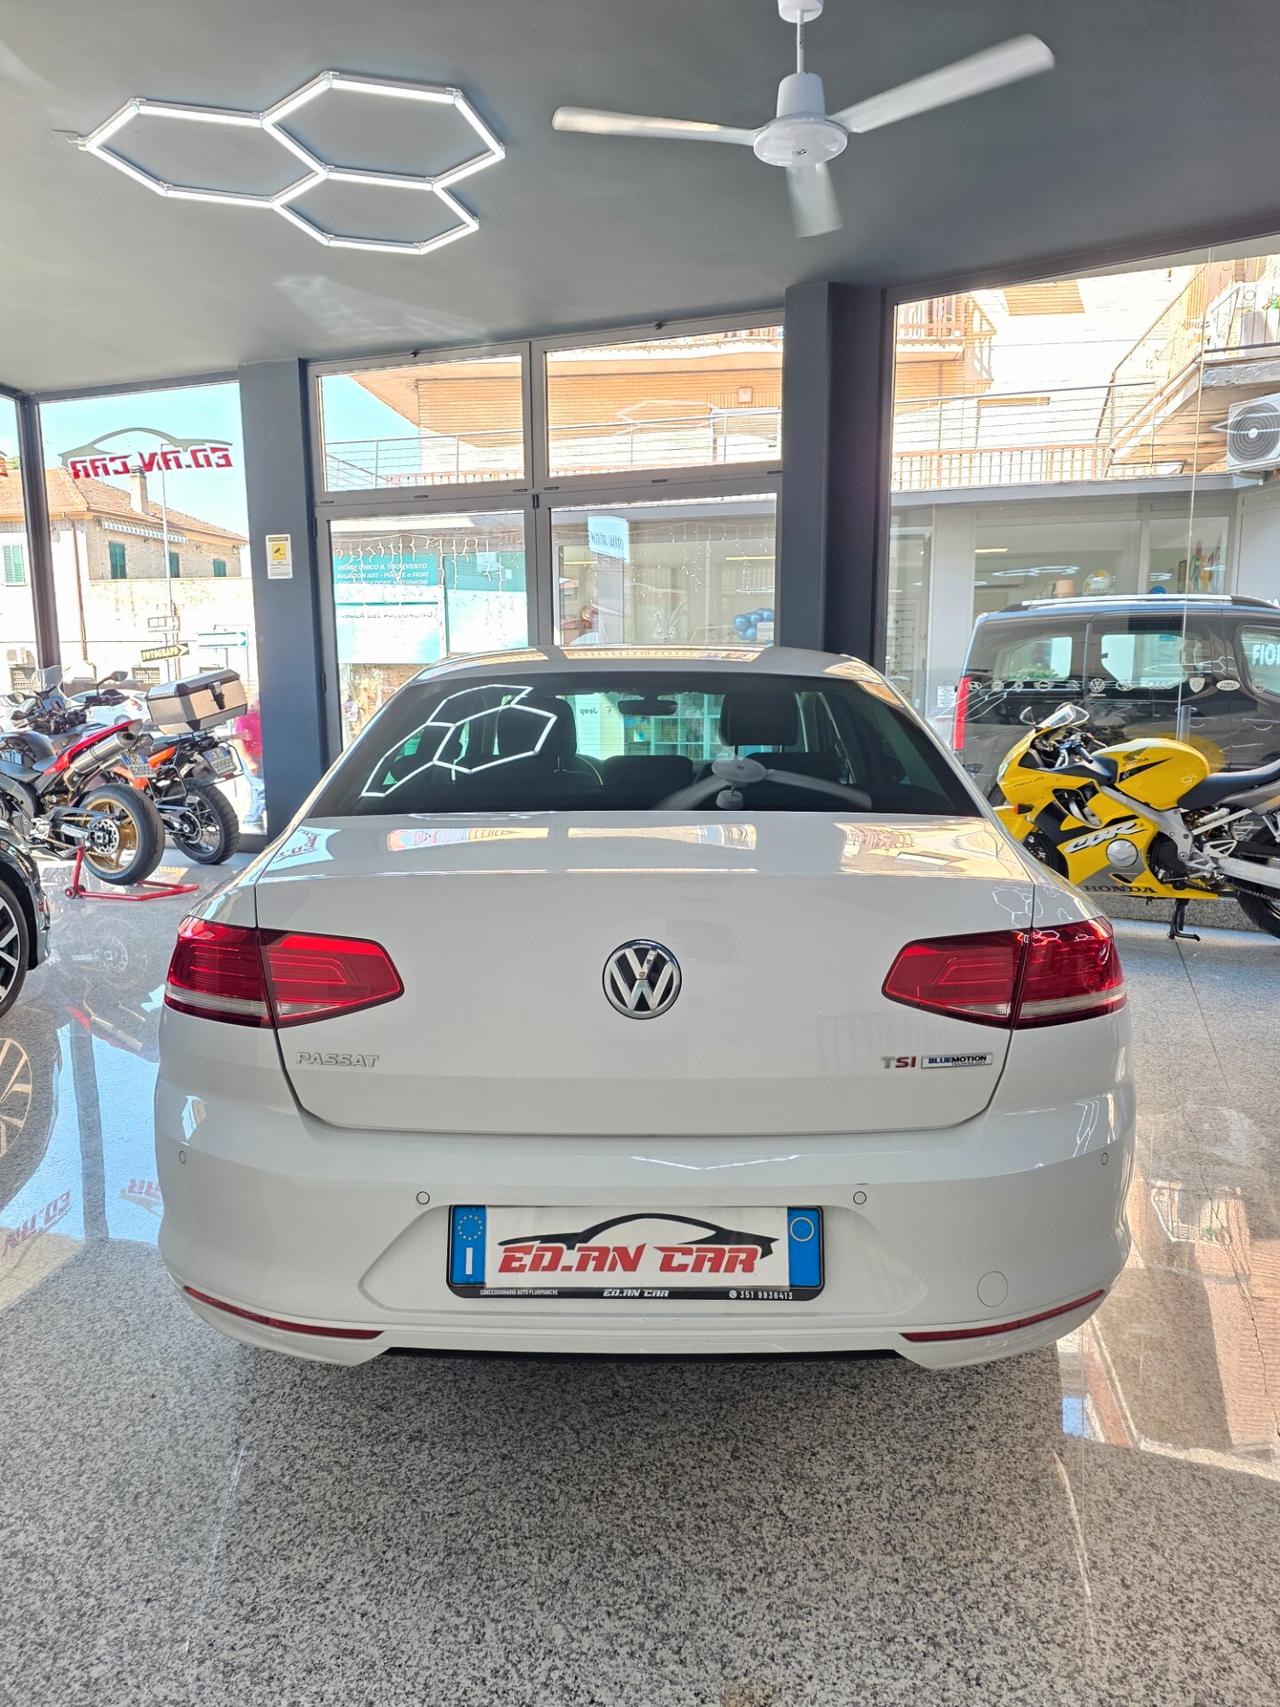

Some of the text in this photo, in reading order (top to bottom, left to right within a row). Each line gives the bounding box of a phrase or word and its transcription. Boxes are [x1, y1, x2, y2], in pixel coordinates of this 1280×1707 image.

[1252, 644, 1280, 666] FIO
[1084, 885, 1158, 894] HONDA
[296, 1051, 379, 1067] PASSAT
[881, 1056, 916, 1068] TSI
[928, 1055, 987, 1064] BLUEMOTION
[498, 1243, 760, 1273] ED.AN CAR
[603, 1289, 670, 1298] ED.AN CAR
[740, 1290, 754, 1299] 351
